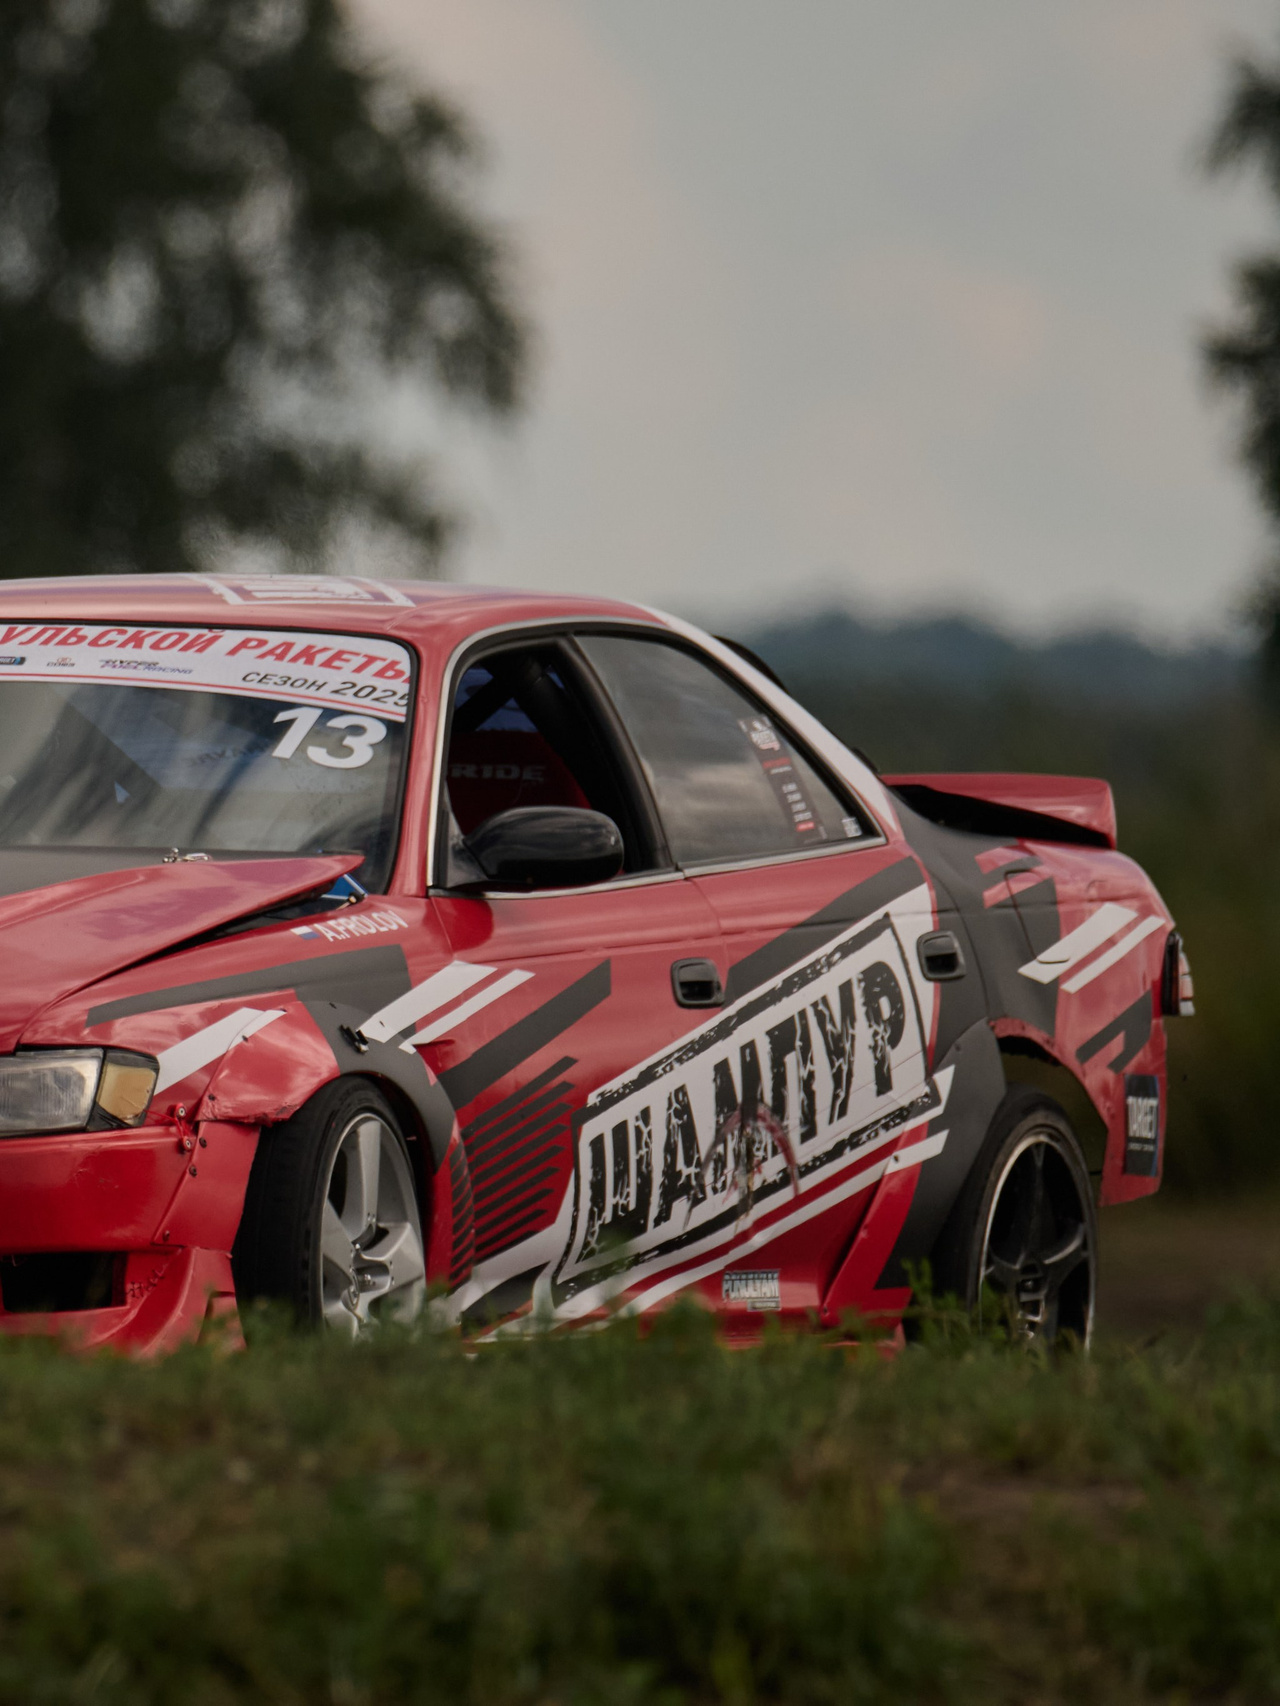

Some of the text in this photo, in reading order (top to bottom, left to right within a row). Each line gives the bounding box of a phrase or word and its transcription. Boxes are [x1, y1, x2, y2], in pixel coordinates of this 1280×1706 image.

[241, 671, 409, 707] СЕЗОН 2025
[271, 707, 388, 769] 13
[449, 763, 547, 782] RIDE
[314, 909, 409, 942] A.FROLOV
[574, 960, 906, 1266] ШАМПУР
